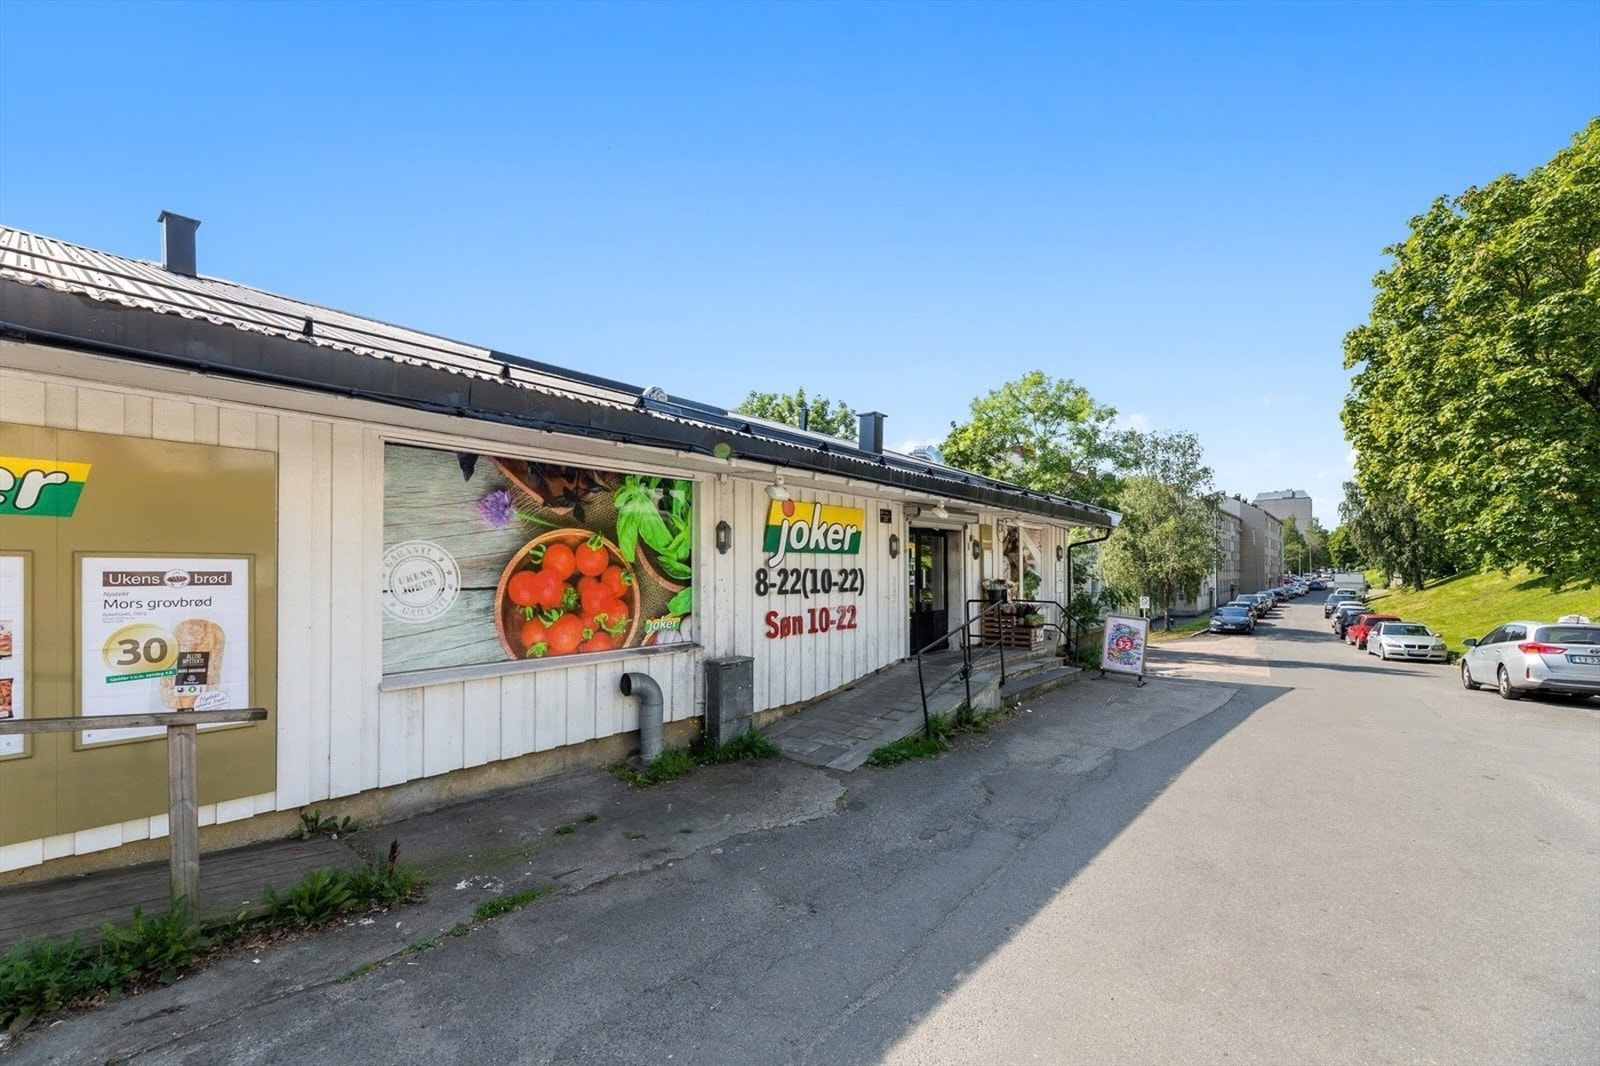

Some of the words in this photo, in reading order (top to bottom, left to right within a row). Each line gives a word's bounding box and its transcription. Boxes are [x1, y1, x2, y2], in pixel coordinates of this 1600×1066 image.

[768, 499, 858, 569] joker
[109, 573, 161, 585] Ukens
[194, 573, 227, 584] brød
[398, 568, 433, 585] UKENS
[103, 599, 143, 609] Mors
[147, 596, 212, 611] grovbrød
[646, 615, 678, 634] joker
[765, 610, 803, 639] Søn
[807, 605, 857, 634] 10-22
[117, 637, 168, 665] 30
